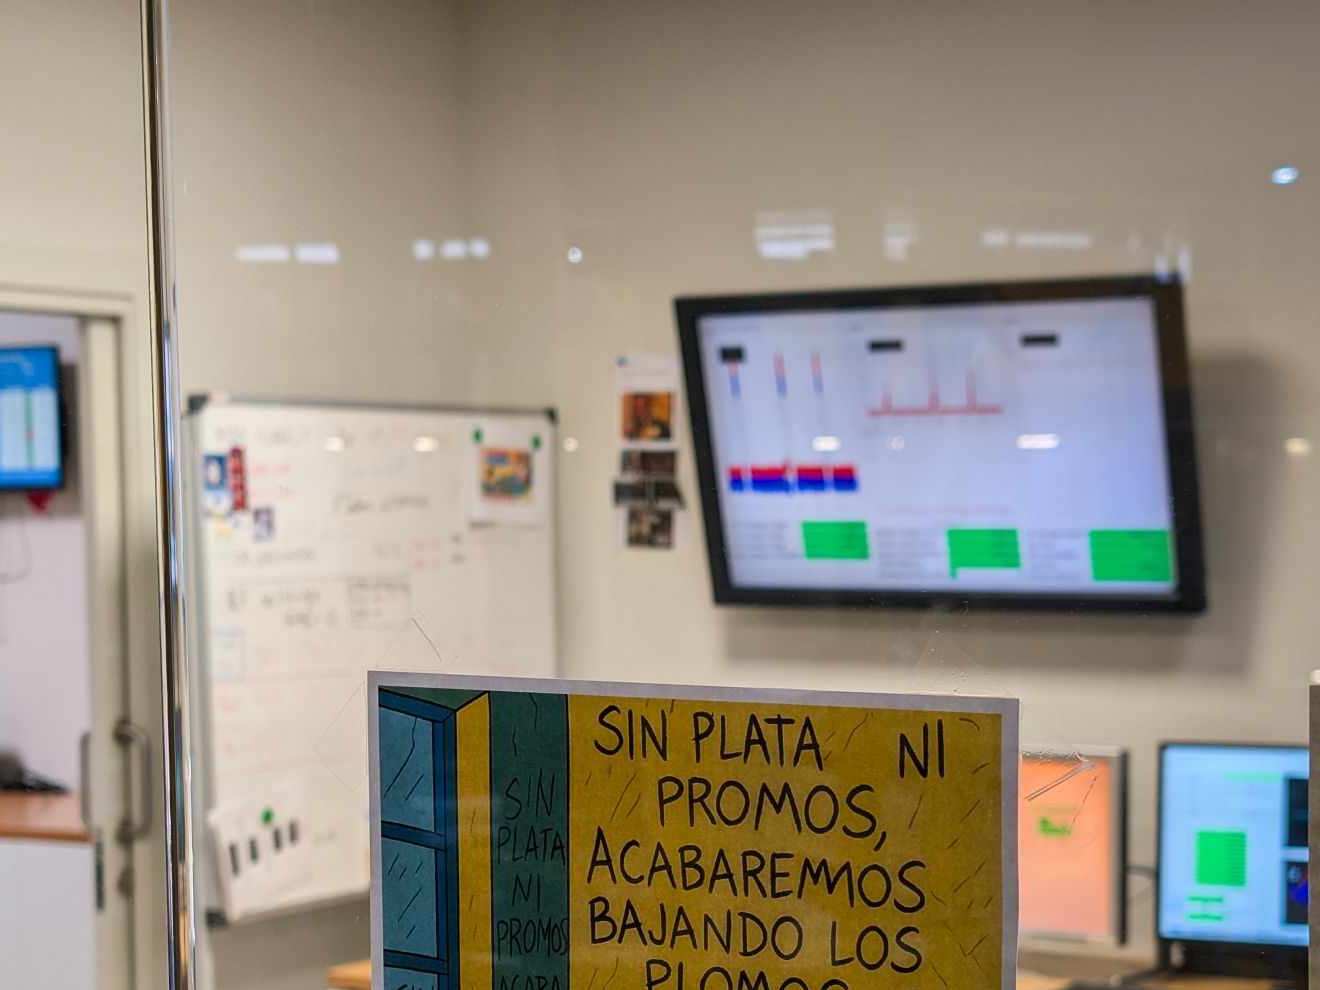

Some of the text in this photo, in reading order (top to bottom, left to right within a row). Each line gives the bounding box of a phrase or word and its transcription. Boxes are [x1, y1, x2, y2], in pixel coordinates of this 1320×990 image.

[594, 705, 944, 778] SIN PLATA NI
[505, 768, 555, 820] SIN
[658, 776, 887, 851] PROMOS,
[498, 826, 565, 866] PLATA
[512, 874, 540, 912] NI
[497, 918, 568, 960] PROMOS
[589, 896, 922, 973] BAJANDO LOS
